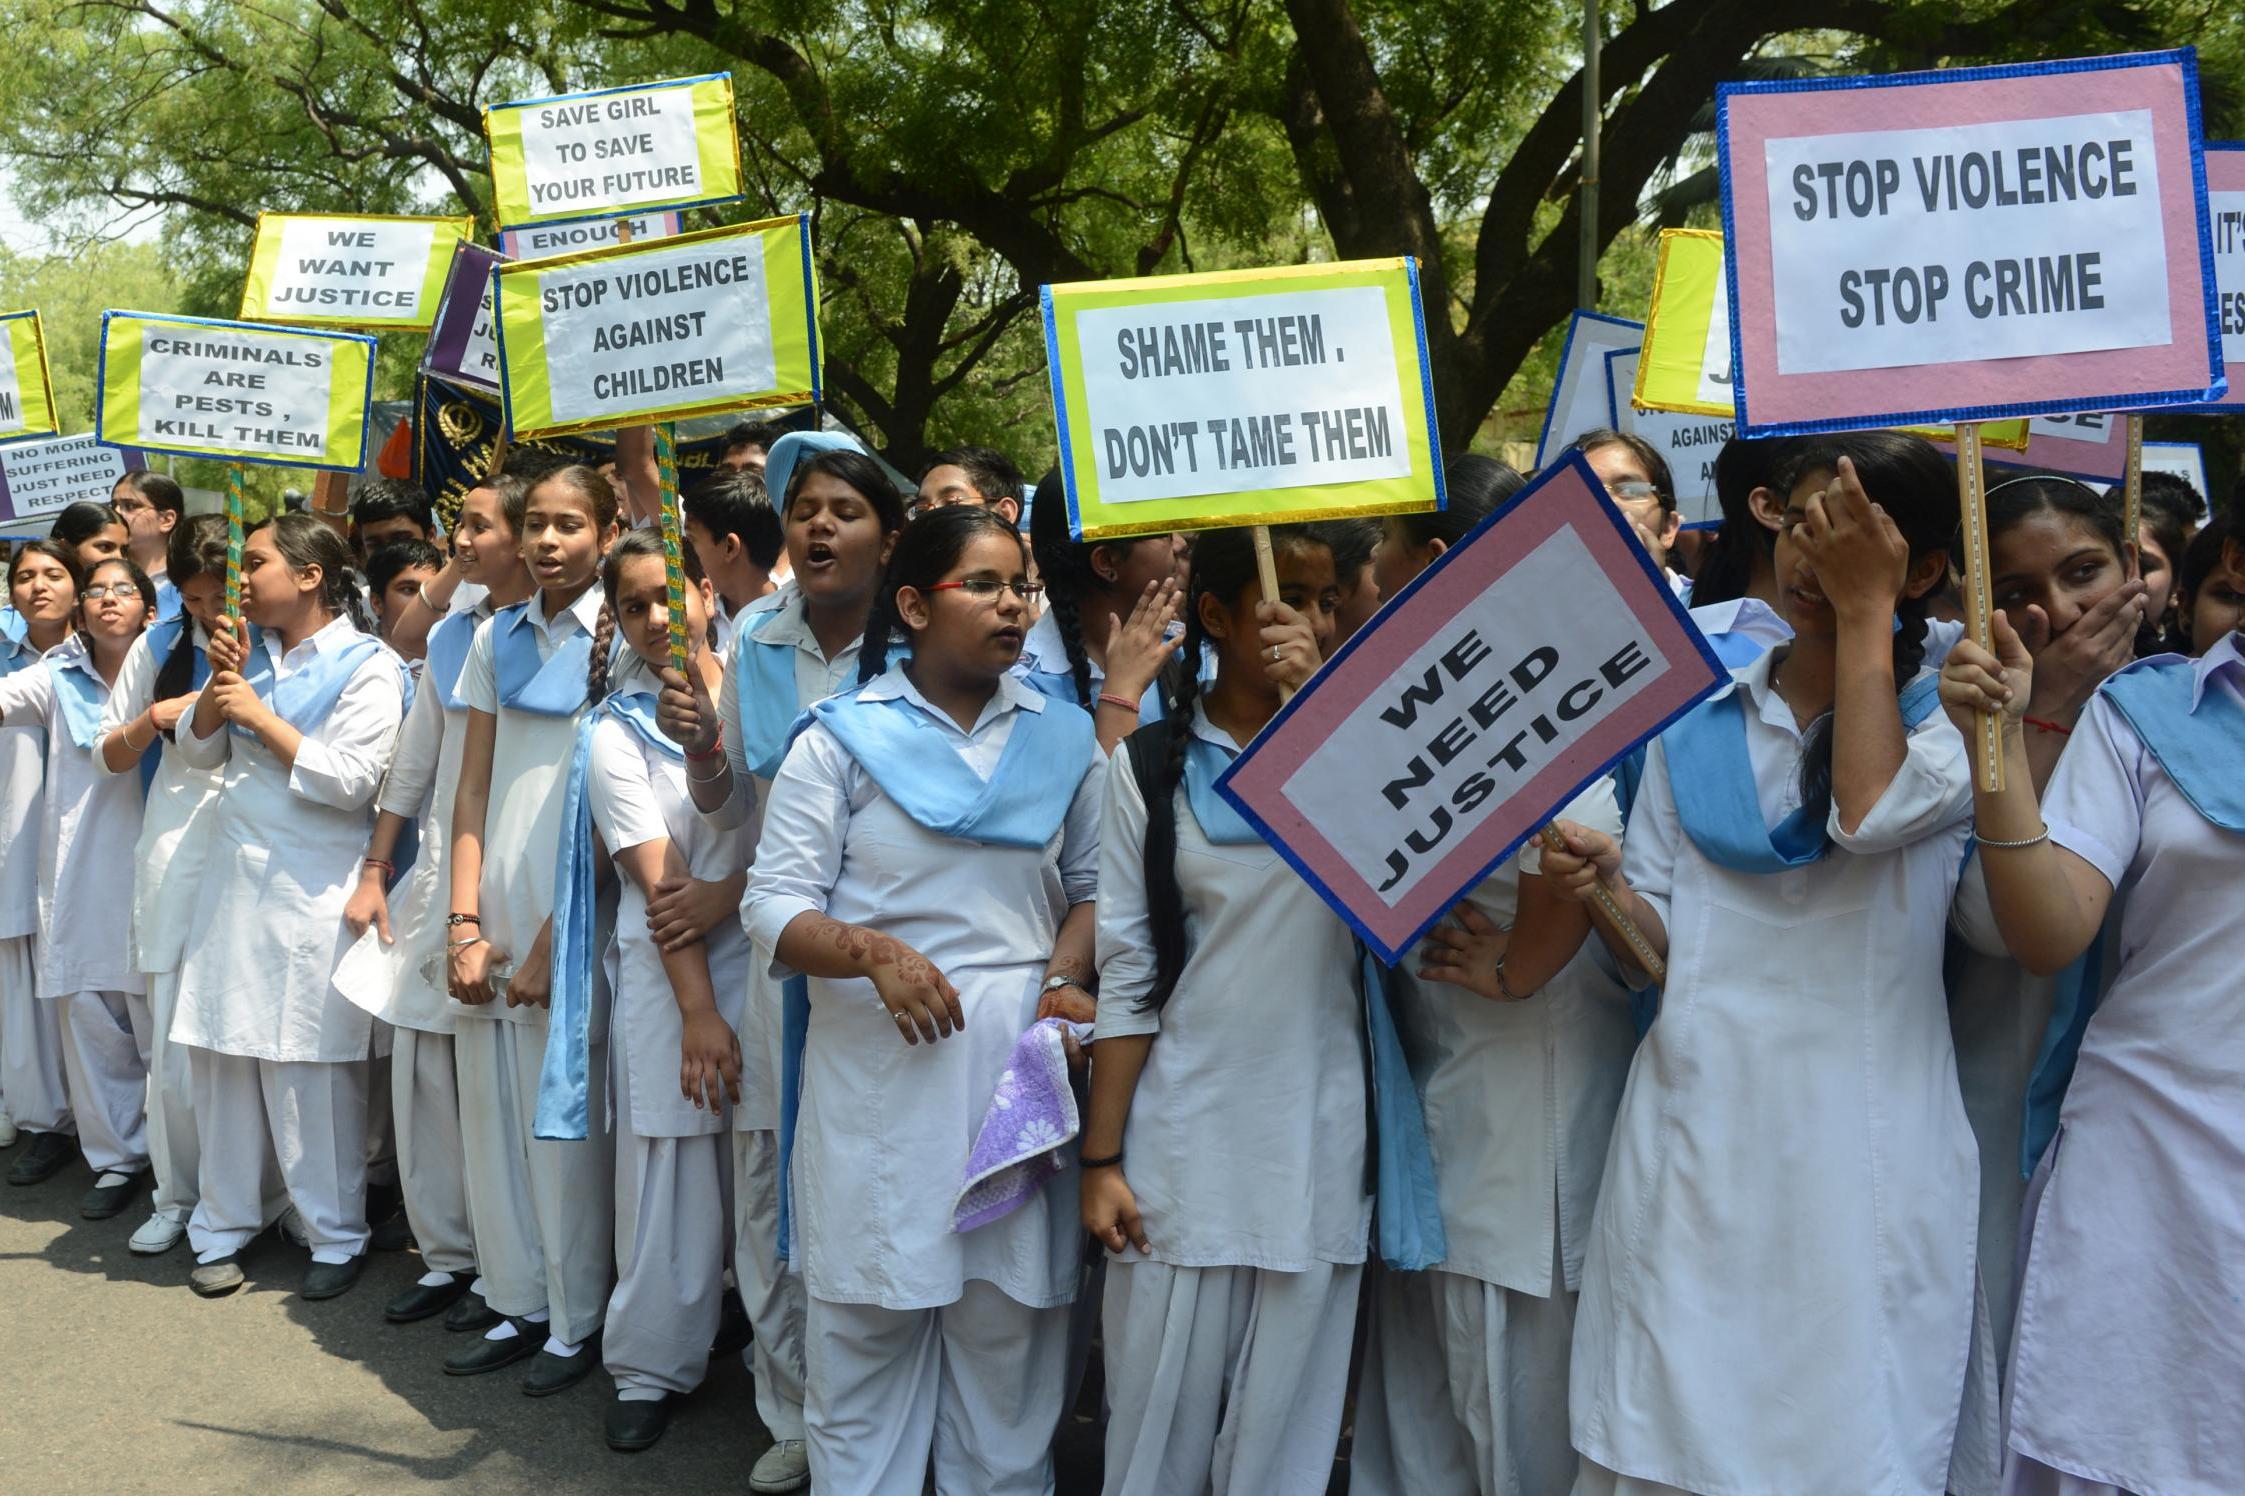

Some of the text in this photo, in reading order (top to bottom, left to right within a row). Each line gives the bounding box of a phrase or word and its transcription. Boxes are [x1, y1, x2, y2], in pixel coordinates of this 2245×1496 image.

[540, 96, 662, 130] SAVE GIRL
[556, 133, 654, 164] TO SAVE
[531, 165, 695, 204] YOUR FUTURE
[1792, 139, 2138, 222] STOP VIOLENCE
[327, 231, 376, 249] WE
[298, 259, 395, 277] WANT
[274, 287, 416, 308] JUSTICE
[543, 255, 750, 314] STOP VIOLENCE
[1840, 252, 2105, 330] STOP CRIME
[593, 311, 707, 353] AGAINST
[1117, 321, 1230, 380] SHAME
[1234, 314, 1327, 370] THEM
[149, 338, 323, 369] CRIMINALS
[203, 372, 266, 391] ARE
[593, 357, 725, 401] CHILDREN
[175, 394, 273, 417] PESTS
[11, 438, 97, 461] NO MORE
[154, 419, 320, 449] KILL THEM
[1104, 406, 1392, 480] DON'T TAME THEM
[6, 452, 113, 479] SUFFERING
[12, 468, 116, 495] JUST NEED
[28, 485, 112, 508] RESPECT
[1379, 629, 1493, 731] WE
[1381, 645, 1560, 811] NEED
[1377, 640, 1652, 893] JUSTICE
